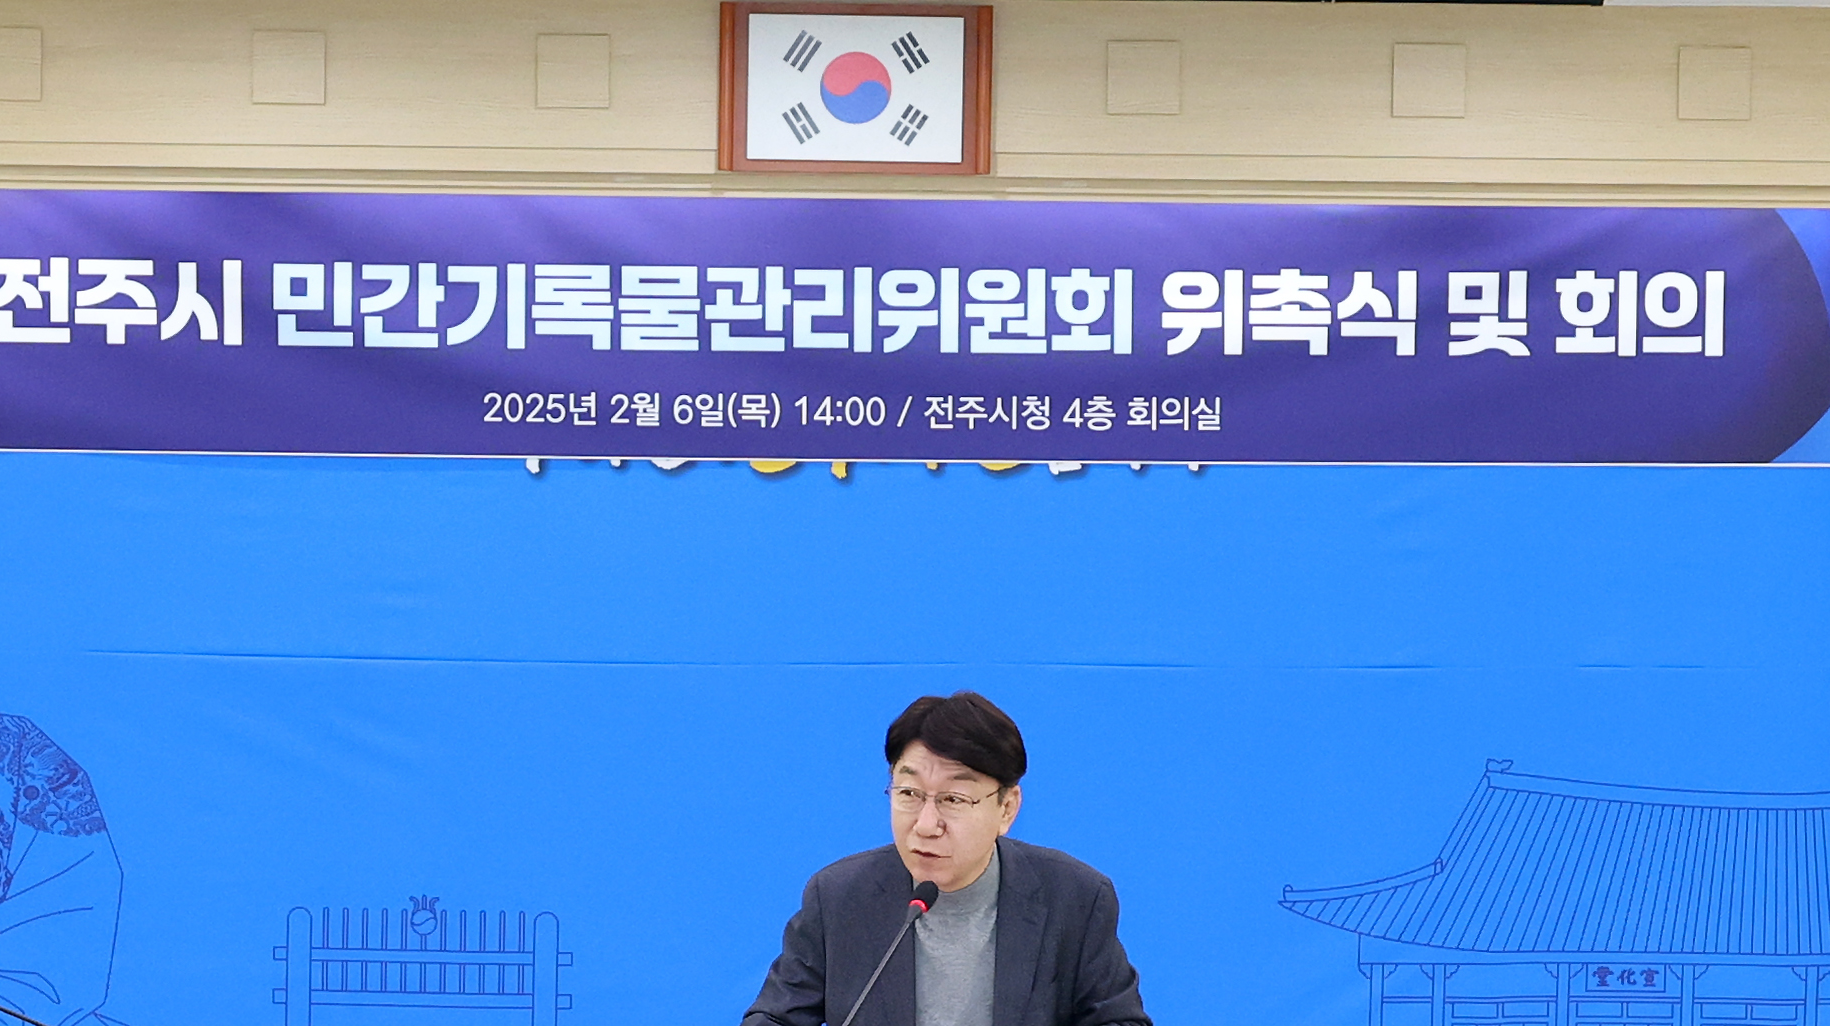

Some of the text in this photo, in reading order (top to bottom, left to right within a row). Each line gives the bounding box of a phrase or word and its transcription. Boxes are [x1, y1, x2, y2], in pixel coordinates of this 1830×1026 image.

[273, 261, 1133, 356] 민간기록물관리위원회
[1162, 268, 1418, 356] 위촉식
[1448, 270, 1531, 357] 및
[1555, 270, 1724, 357] 회의
[483, 392, 597, 426] 2025년
[610, 393, 660, 427] 2월
[673, 393, 781, 428] 6일(목)
[794, 396, 886, 426] 14:00
[924, 395, 1051, 430] 전주시청
[1063, 396, 1117, 431] 4층
[1127, 396, 1221, 431] 회의실
